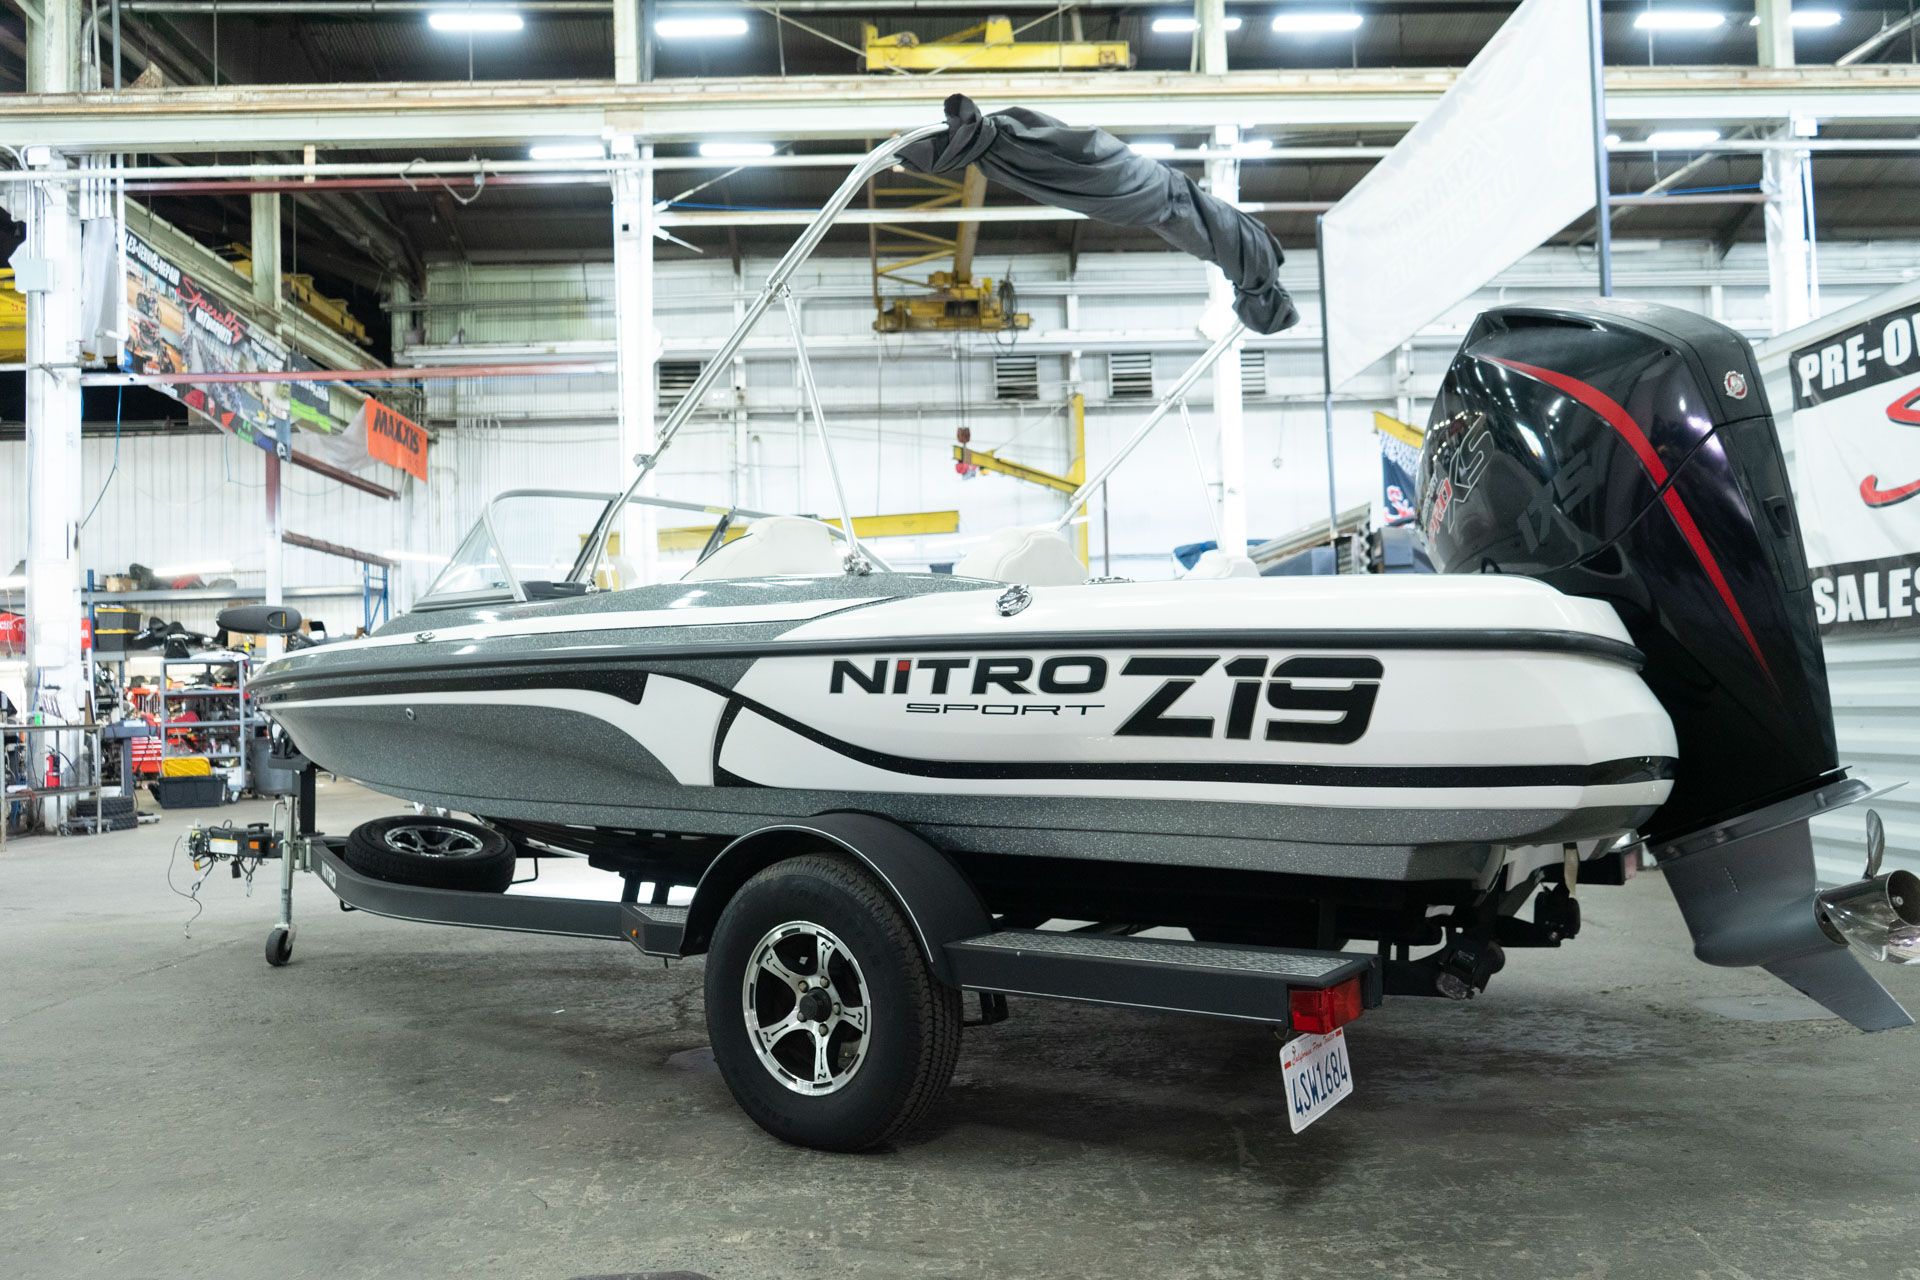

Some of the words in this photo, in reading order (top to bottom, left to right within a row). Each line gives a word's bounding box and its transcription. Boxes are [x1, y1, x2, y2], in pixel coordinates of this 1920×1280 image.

[1798, 312, 1920, 398] PRE-O
[373, 408, 419, 454] MAXXIS
[1447, 414, 1495, 534] XS
[1811, 567, 1920, 625] SALE
[830, 655, 1109, 695] NITRO
[1112, 653, 1385, 745] Z19
[905, 702, 1106, 716] SPORT
[1291, 1047, 1348, 1115] 4SW1684
